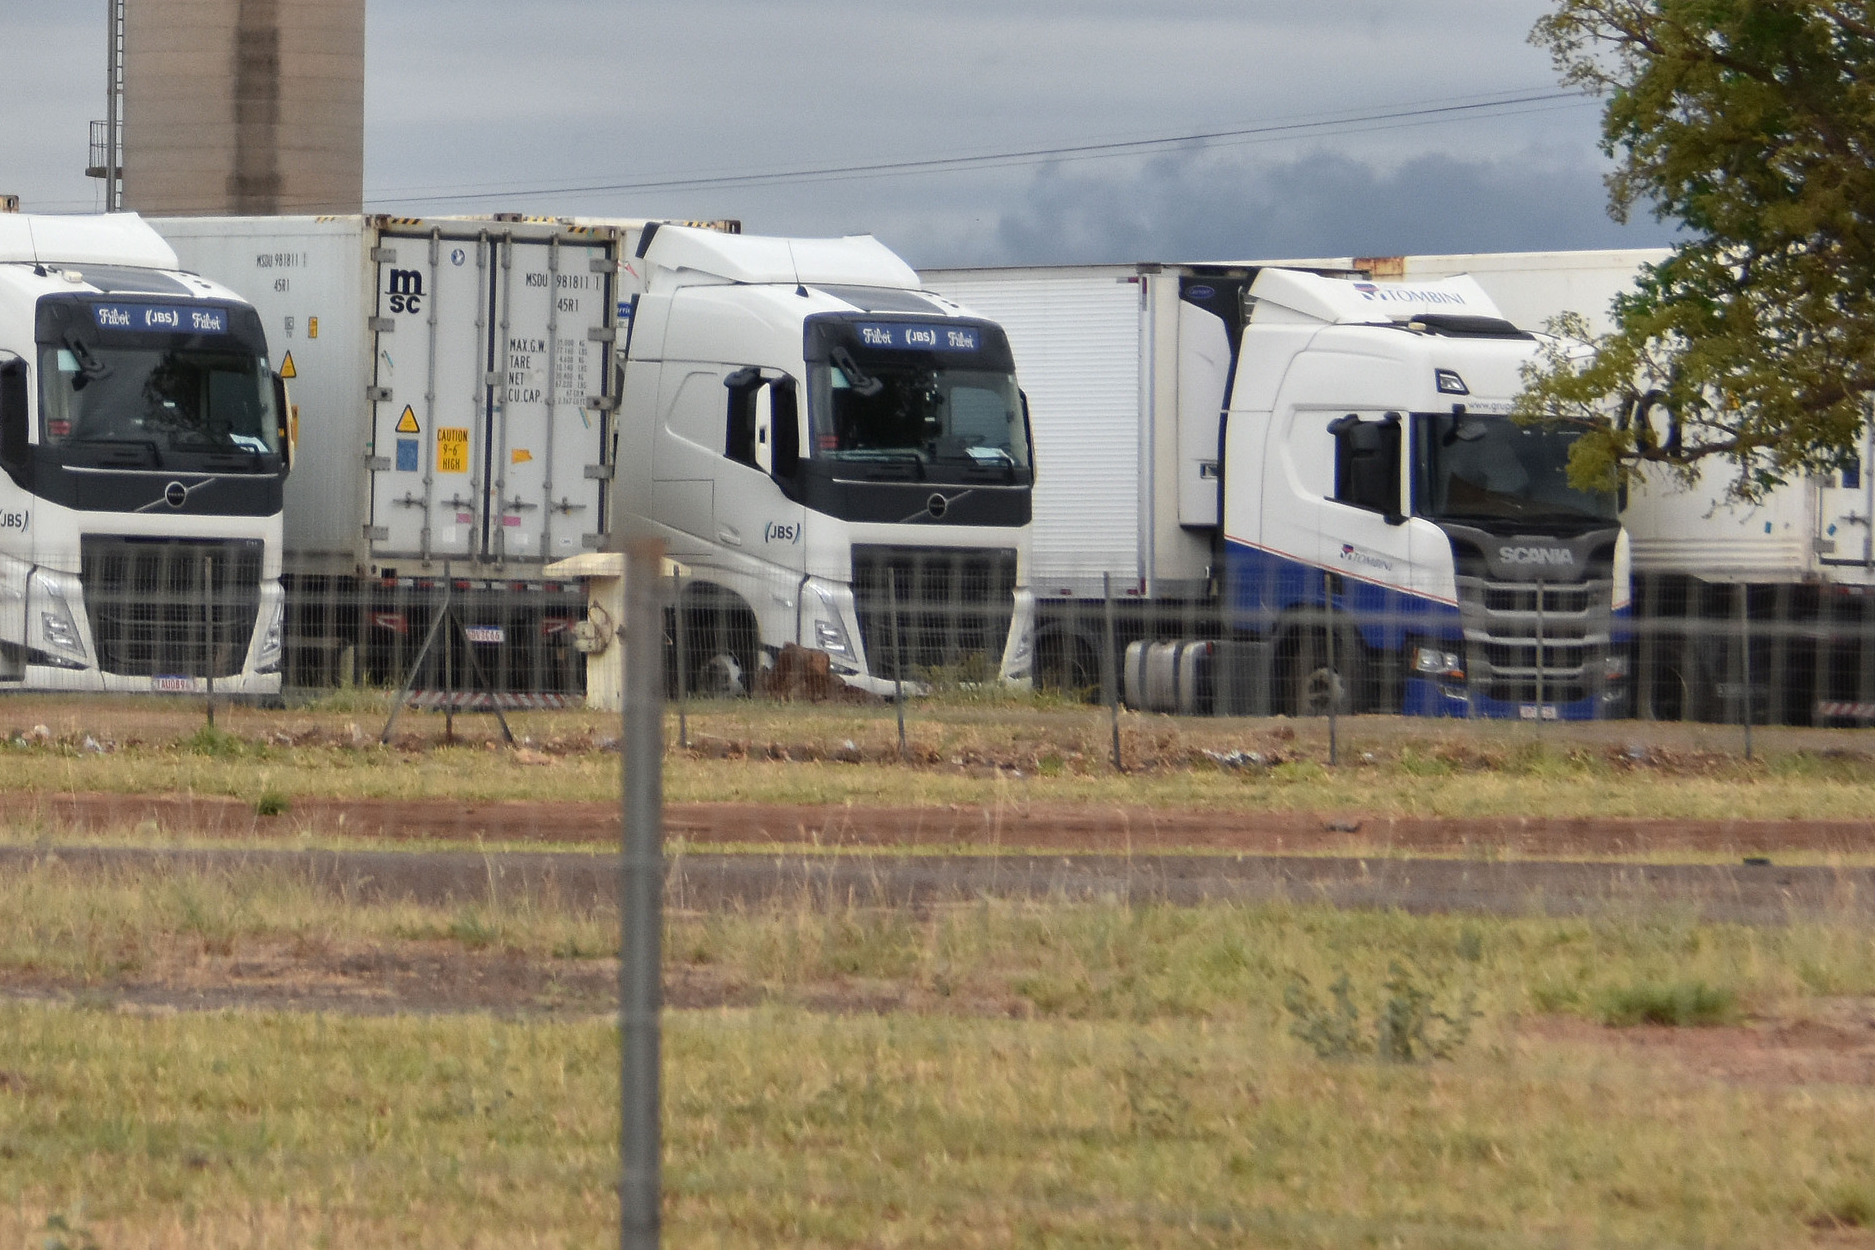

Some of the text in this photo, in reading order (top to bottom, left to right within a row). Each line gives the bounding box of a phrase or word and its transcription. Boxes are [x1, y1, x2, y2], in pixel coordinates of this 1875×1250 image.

[526, 273, 548, 288] MSDU
[556, 274, 589, 289] 981811
[1385, 290, 1466, 304] TOMBINI
[557, 298, 579, 312] 45R1
[98, 308, 130, 326] Friboi
[192, 312, 221, 330] Friboi
[863, 328, 892, 344] Friboi
[947, 331, 974, 348] Friboi
[510, 355, 531, 369] TARE
[509, 372, 525, 386] NET
[437, 429, 468, 442] CAUTION
[442, 458, 461, 471] HIGH
[1499, 547, 1573, 565] SCANIA
